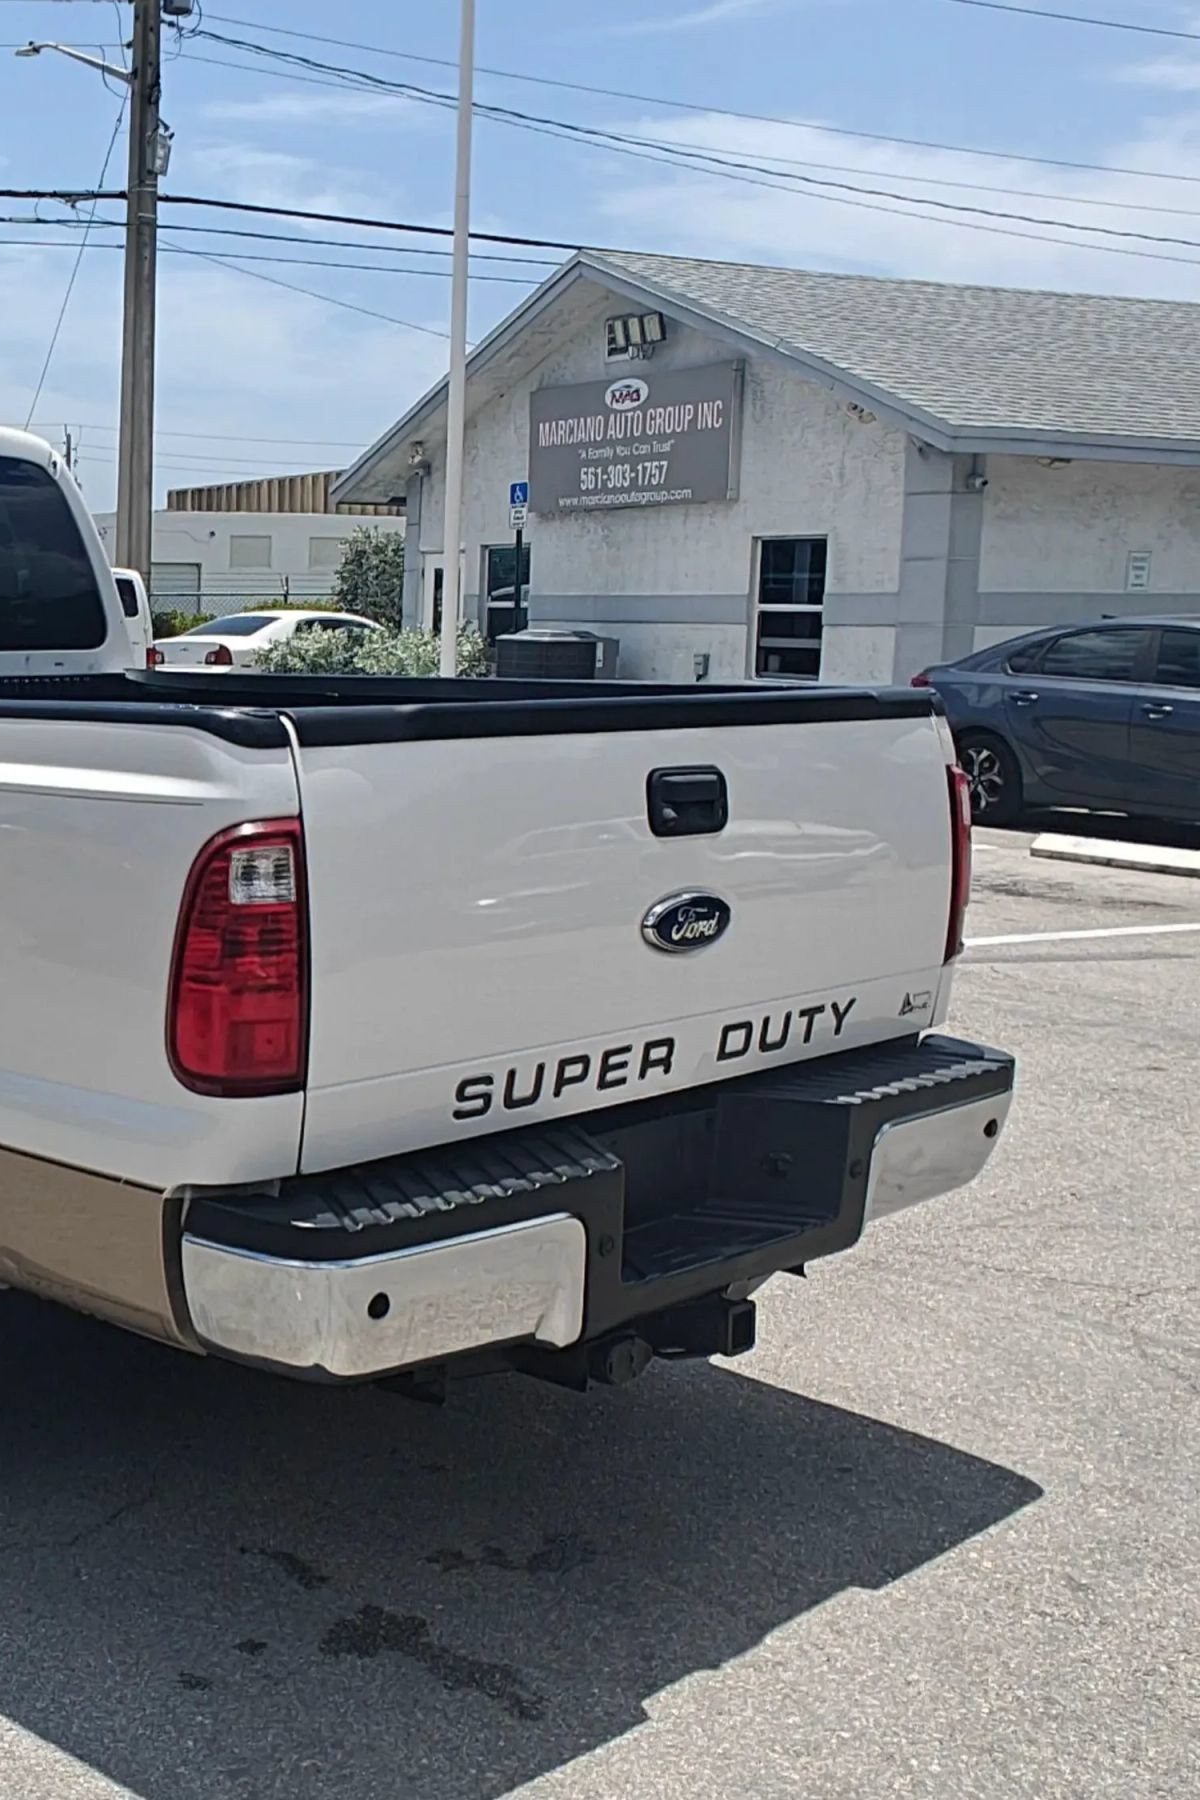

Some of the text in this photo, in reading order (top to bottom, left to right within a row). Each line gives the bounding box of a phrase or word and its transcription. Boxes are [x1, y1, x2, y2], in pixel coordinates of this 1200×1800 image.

[538, 399, 724, 448] MARCIANO AUTO GROUP INC
[587, 446, 615, 461] Family
[616, 444, 631, 457] You
[632, 442, 652, 456] Can
[580, 460, 669, 491] 561-303-1757
[558, 488, 693, 508] www.marcianoautogroup.com
[671, 906, 720, 941] Ford
[452, 997, 857, 1121] SUPER DUTY
